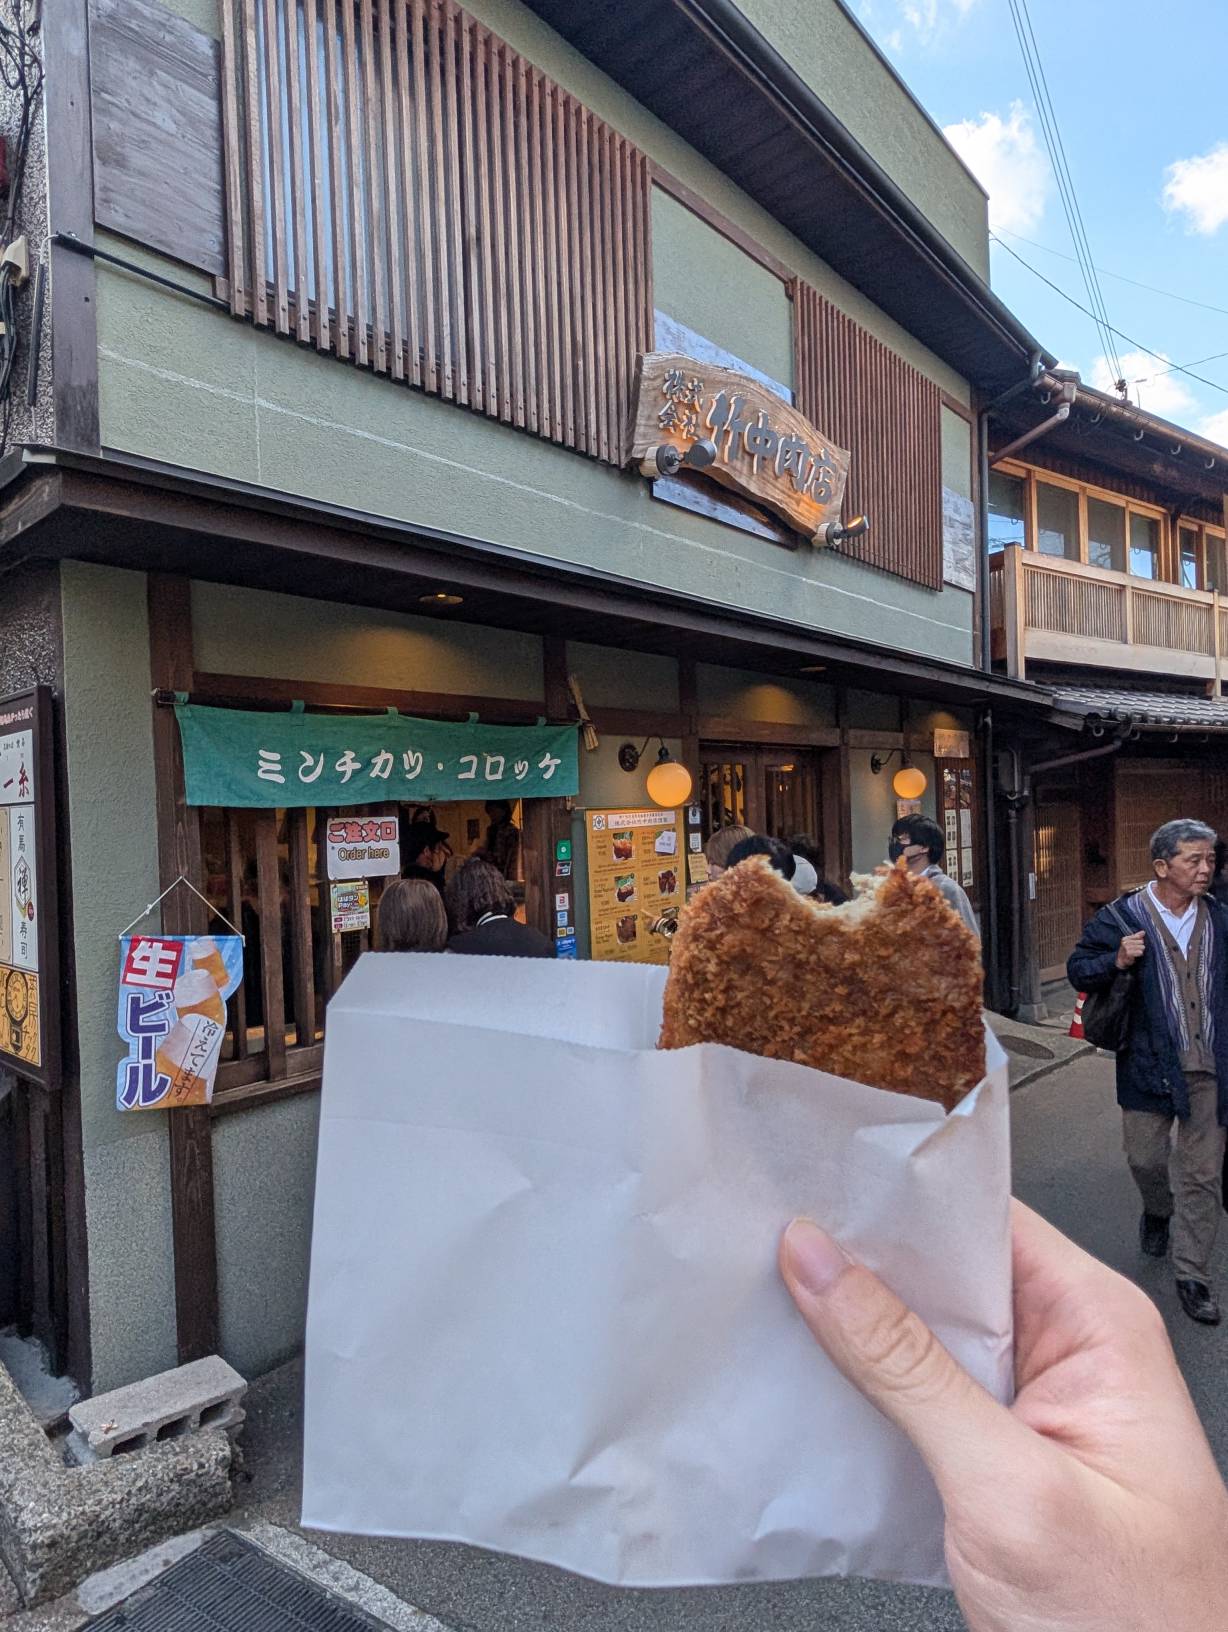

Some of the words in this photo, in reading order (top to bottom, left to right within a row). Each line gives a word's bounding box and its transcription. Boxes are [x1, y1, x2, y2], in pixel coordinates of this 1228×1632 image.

[706, 389, 837, 505] 竹中肉店
[257, 749, 562, 784] ミンチカツ・コロッケ
[338, 847, 366, 861] Order
[368, 846, 390, 860] here
[120, 941, 178, 1108] 生ビール
[174, 1020, 219, 1099] 冷えてます
